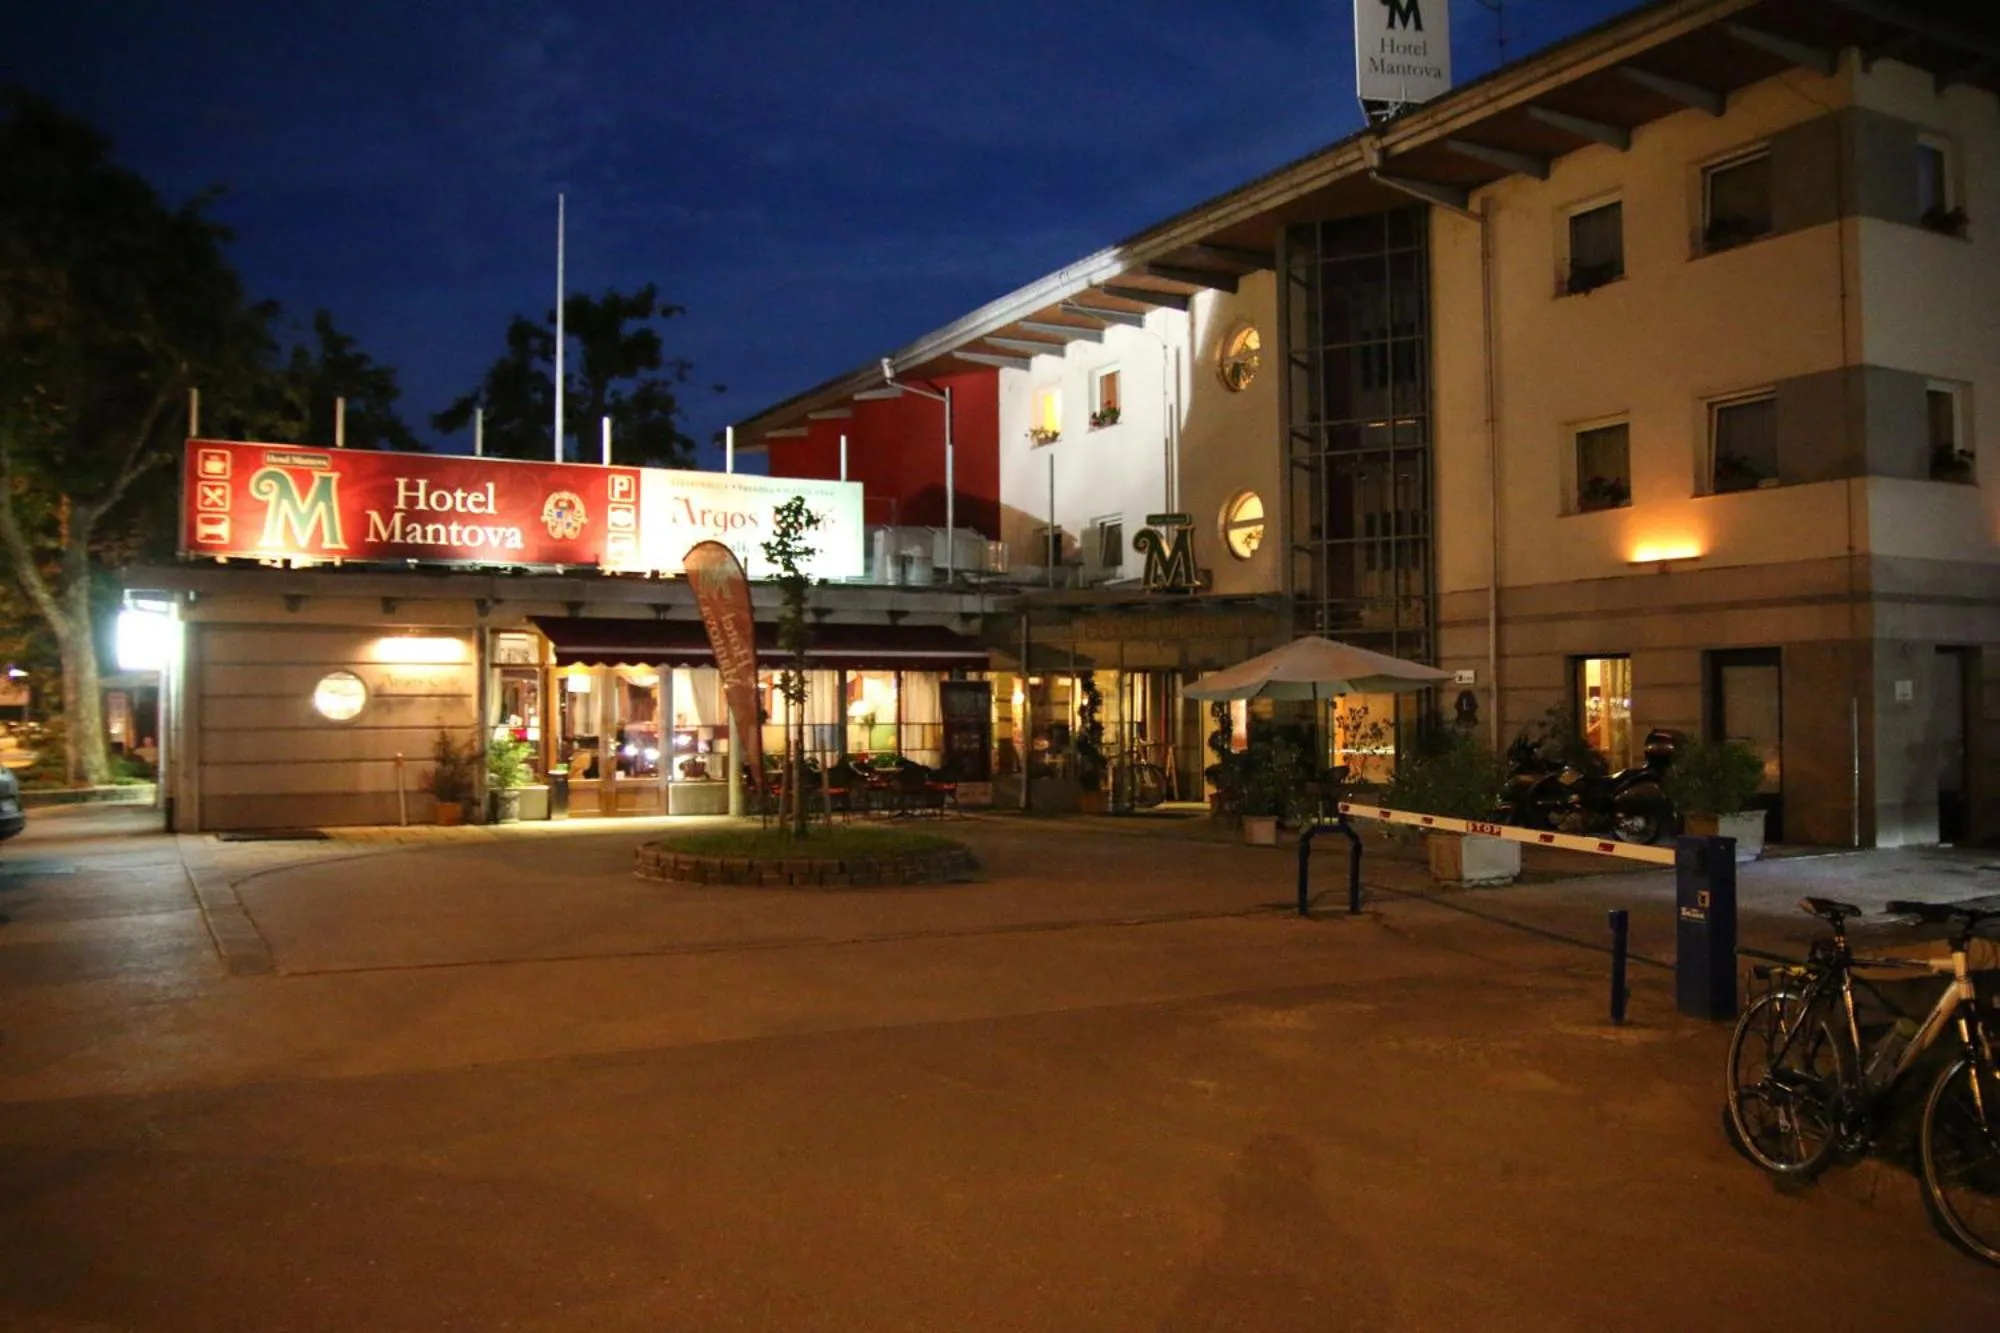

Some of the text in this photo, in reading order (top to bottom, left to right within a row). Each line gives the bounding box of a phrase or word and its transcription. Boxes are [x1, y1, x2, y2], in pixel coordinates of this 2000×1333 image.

[1380, 37, 1428, 57] Hotel
[1369, 57, 1442, 79] Mantova
[394, 477, 498, 514] Hotel
[672, 495, 759, 534] Argos
[365, 510, 525, 549] Mantova
[1468, 821, 1501, 836] STOP
